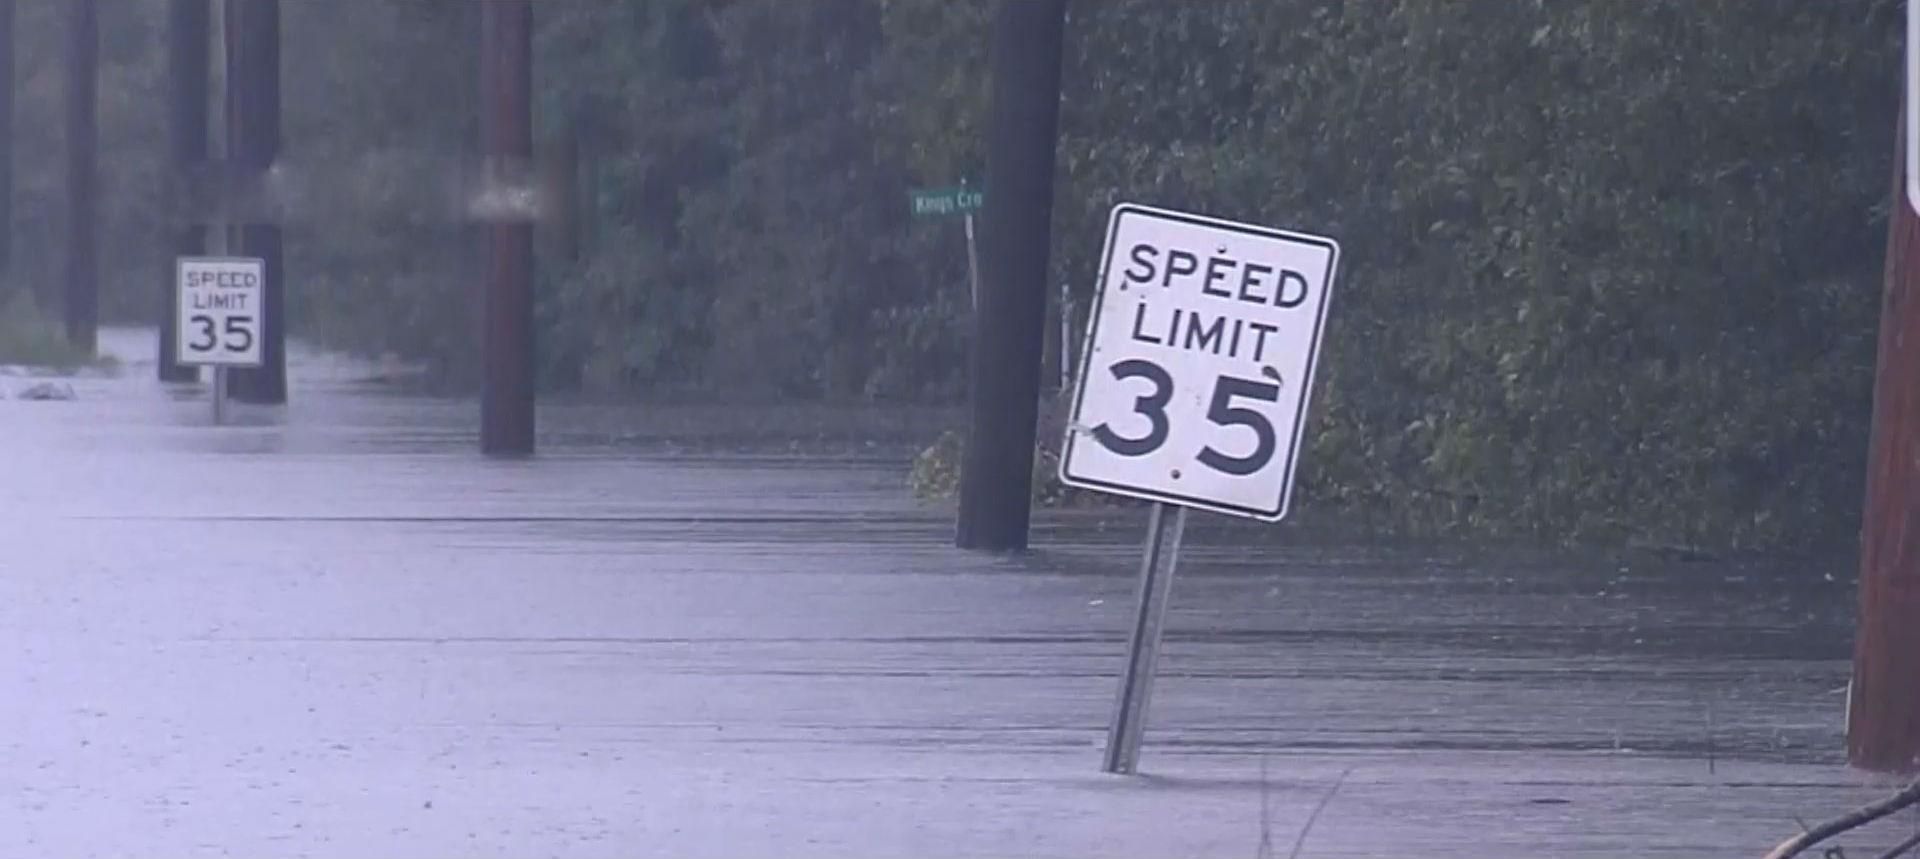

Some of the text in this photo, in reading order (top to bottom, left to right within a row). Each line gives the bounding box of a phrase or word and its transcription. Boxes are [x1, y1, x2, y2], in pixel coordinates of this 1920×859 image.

[187, 271, 257, 288] SPEED
[1124, 244, 1308, 308] SPEED
[193, 293, 248, 309] LIMIT
[189, 315, 253, 353] 35
[1131, 302, 1279, 362] LIMIT
[1091, 359, 1280, 476] 35
